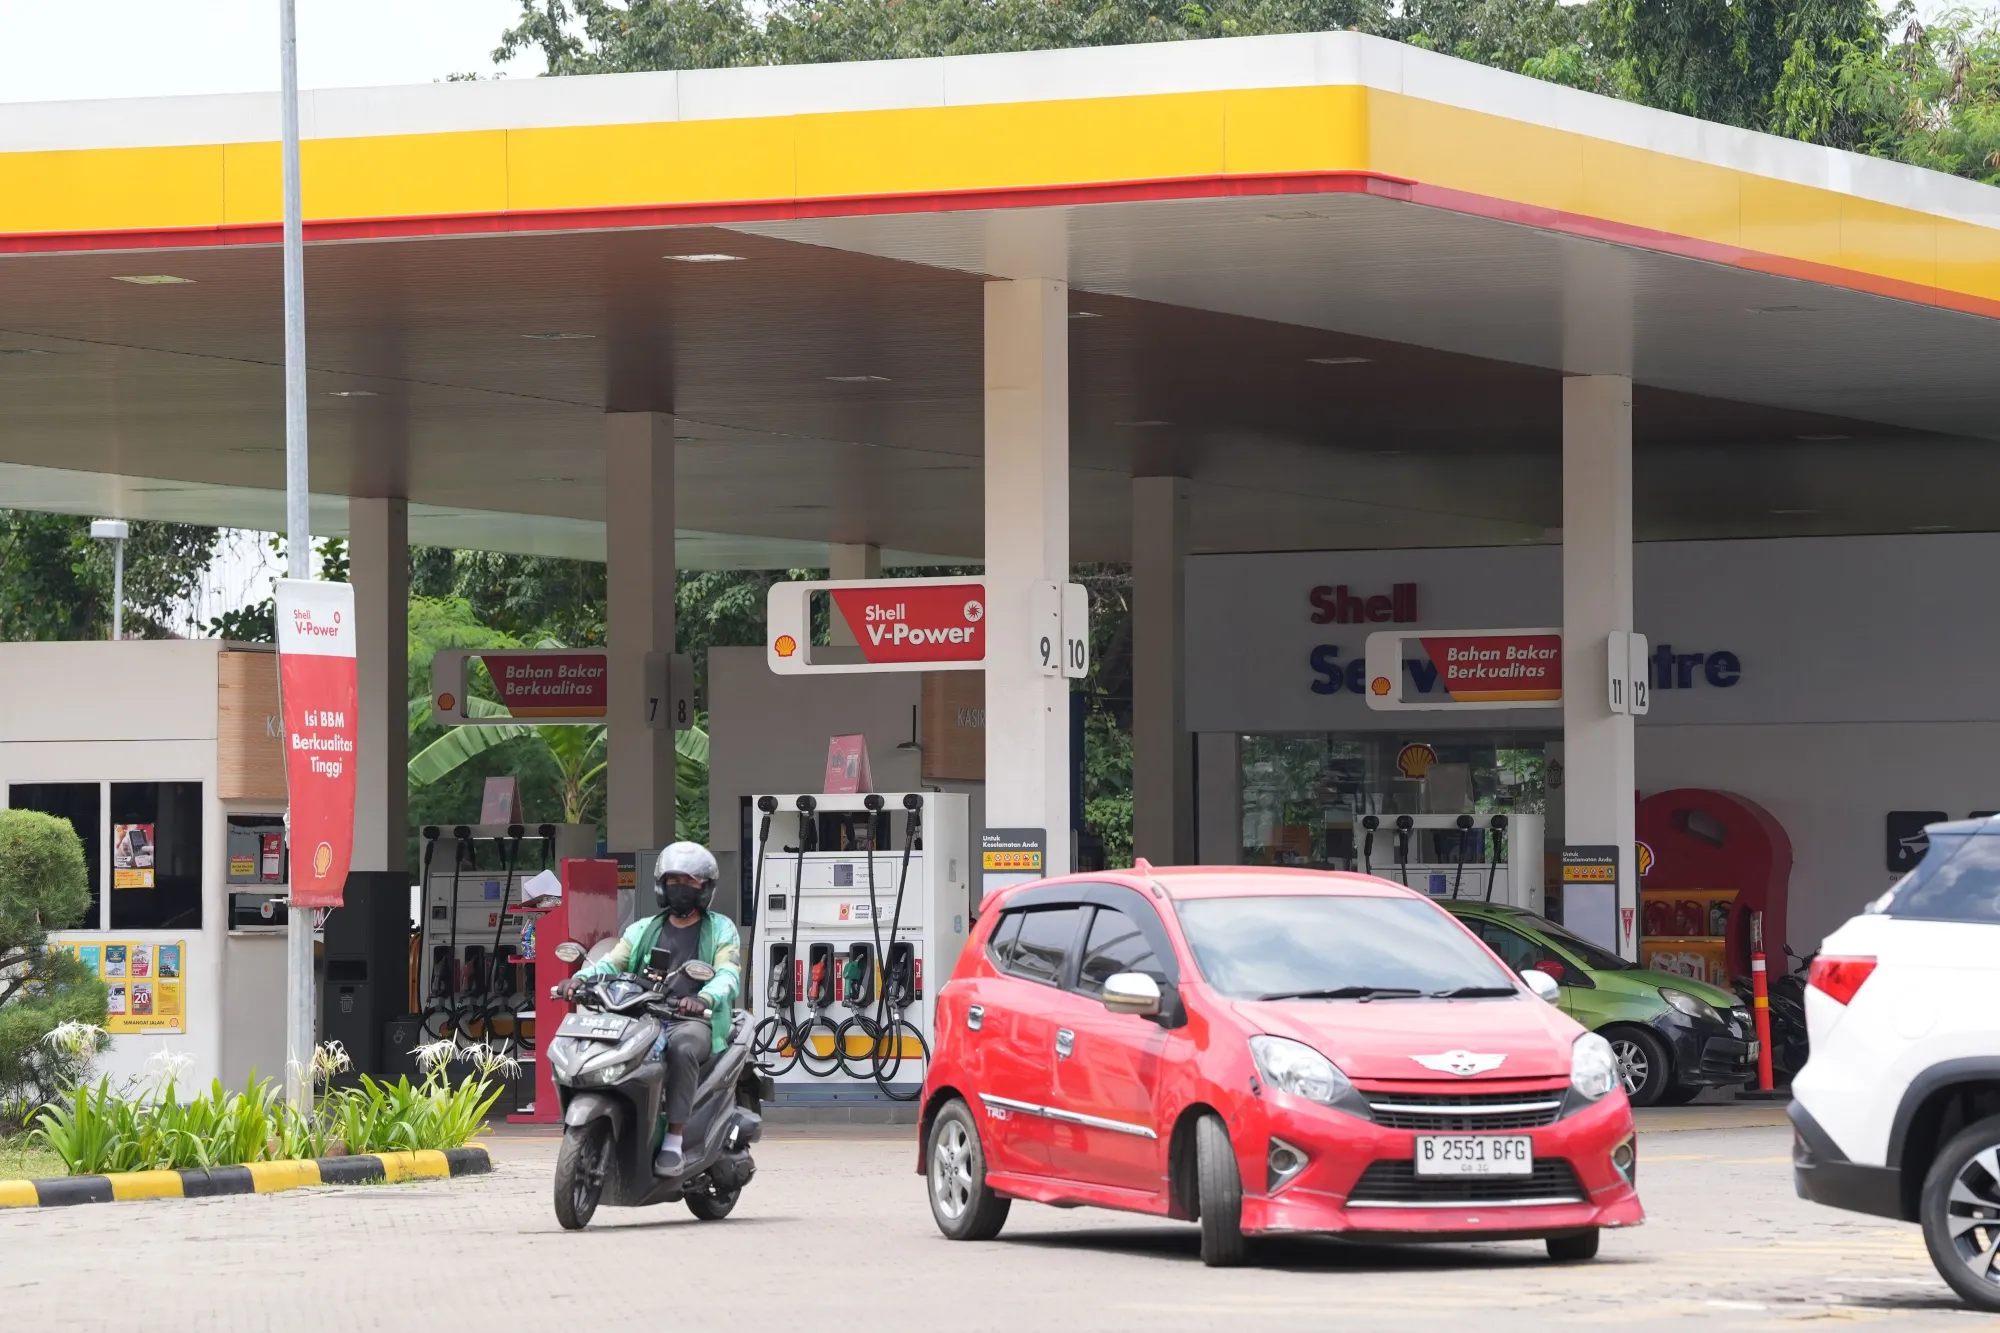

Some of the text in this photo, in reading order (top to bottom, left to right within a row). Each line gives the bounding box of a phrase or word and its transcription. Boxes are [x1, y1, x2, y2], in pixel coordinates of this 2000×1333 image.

[293, 608, 311, 620] Shell
[865, 603, 905, 621] Shell
[1309, 583, 1417, 625] Shell
[295, 621, 339, 637] V-Power
[865, 622, 976, 647] V-Power
[1040, 636, 1051, 667] 9
[1068, 638, 1085, 670] 10
[1447, 645, 1558, 661] Bahan Bakar
[505, 663, 604, 679] Bahan Bakar
[1447, 662, 1546, 679] Berkualitas
[1648, 644, 1741, 689] tre
[505, 680, 593, 696] Berkualitas
[1612, 678, 1622, 705] 11
[1634, 680, 1646, 707] 12
[304, 709, 318, 727] Isi
[320, 711, 345, 728] BBM
[650, 697, 659, 722] 7
[677, 698, 687, 724] 8
[291, 732, 353, 752] Berkualitas
[310, 755, 343, 778] Tinggi
[1423, 1140, 1525, 1161] B 2551 BFG
